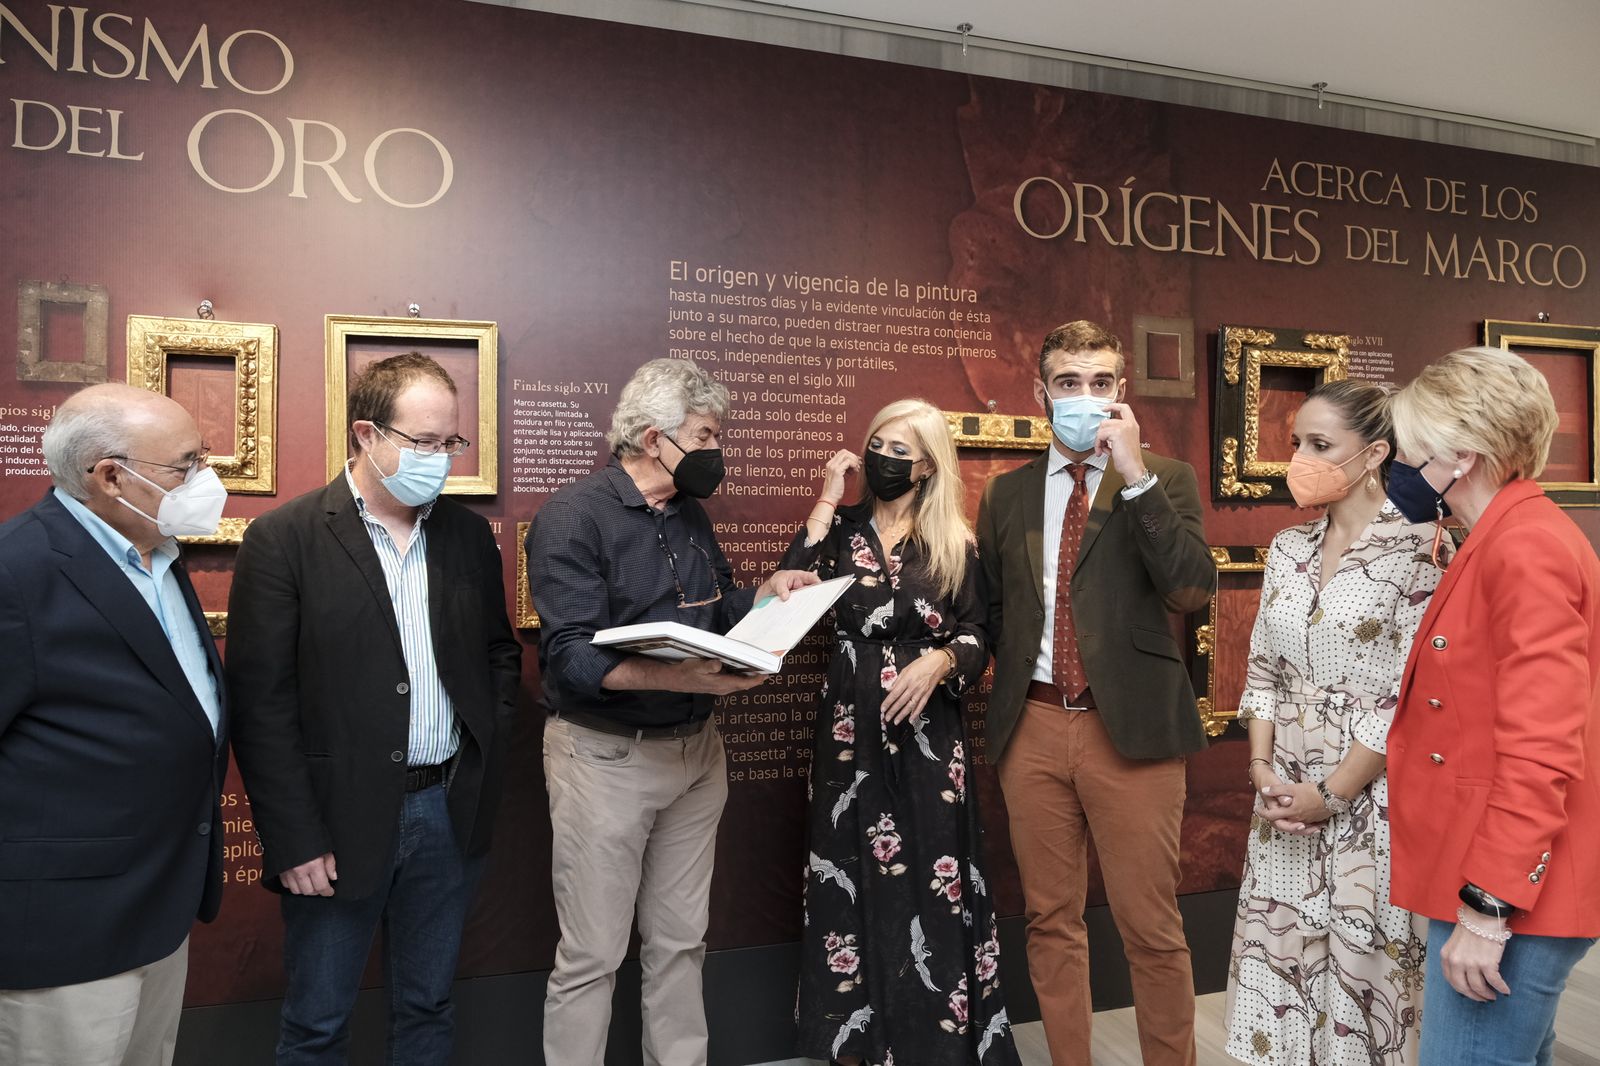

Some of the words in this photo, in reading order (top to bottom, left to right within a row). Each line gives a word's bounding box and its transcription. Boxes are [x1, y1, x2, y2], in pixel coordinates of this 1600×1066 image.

[11, 98, 144, 161] DEL
[187, 109, 454, 208] ORO
[1261, 158, 1411, 208] ACERCA
[1424, 177, 1467, 215] DE
[1481, 184, 1538, 223] LOS
[1013, 176, 1321, 265] ORÍGENES
[1344, 225, 1408, 265] DEL
[1424, 232, 1586, 289] MARCO
[670, 260, 687, 280] El
[696, 266, 758, 288] origen
[766, 273, 776, 292] y
[783, 271, 859, 295] vigencia
[866, 278, 888, 295] de
[896, 279, 909, 297] la
[916, 282, 977, 303] pintura
[670, 288, 705, 303] hasta
[711, 293, 766, 307] nuestros
[771, 296, 796, 309] días
[801, 300, 807, 312] y
[812, 299, 821, 311] la
[827, 301, 877, 315] evidente
[882, 304, 945, 319] vinculación
[949, 309, 962, 321] de
[967, 310, 990, 323] ésta
[668, 307, 702, 323] junto
[708, 313, 714, 322] a
[720, 314, 733, 323] su
[739, 314, 780, 328] marco,
[785, 318, 830, 330] pueden
[835, 319, 881, 333] distraer
[886, 325, 929, 336] nuestra
[934, 328, 992, 341] conciencia
[669, 328, 706, 340] sobre
[711, 330, 721, 341] el
[726, 330, 764, 344] hecho
[769, 333, 784, 345] de
[789, 336, 811, 348] que
[816, 336, 825, 348] la
[830, 338, 889, 351] existencia
[894, 341, 908, 352] de
[912, 344, 943, 354] estos
[947, 345, 996, 358] primeros
[1366, 337, 1382, 346] XVII
[670, 348, 720, 362] marcos,
[725, 349, 821, 366] independientes
[825, 358, 832, 368] y
[837, 356, 897, 372] portátiles,
[713, 369, 764, 383] situarse
[770, 374, 784, 384] en
[789, 373, 799, 384] el
[804, 374, 831, 388] siglo
[836, 374, 855, 387] XIII
[514, 379, 551, 391] Finales
[555, 381, 580, 395] siglo
[584, 383, 608, 394] XVI
[743, 392, 756, 403] ya
[761, 390, 845, 405] documentada
[514, 409, 553, 417] decoración,
[766, 409, 790, 421] solo
[795, 410, 831, 423] desde
[836, 411, 846, 423] el
[728, 428, 832, 442] contemporáneos
[513, 447, 545, 456] conjunto;
[746, 446, 761, 457] de
[766, 446, 783, 458] los
[746, 464, 786, 478] lienzo,
[791, 468, 805, 477] en
[727, 482, 815, 496] Renacimiento.
[741, 559, 756, 571] de
[769, 675, 782, 684] se
[742, 696, 748, 704] a
[730, 712, 786, 724] artesano
[792, 709, 801, 721] la
[770, 728, 785, 740] de
[727, 746, 792, 762] "cassetta"
[730, 771, 744, 781] se
[749, 768, 778, 780] basa
[783, 765, 793, 778] la
